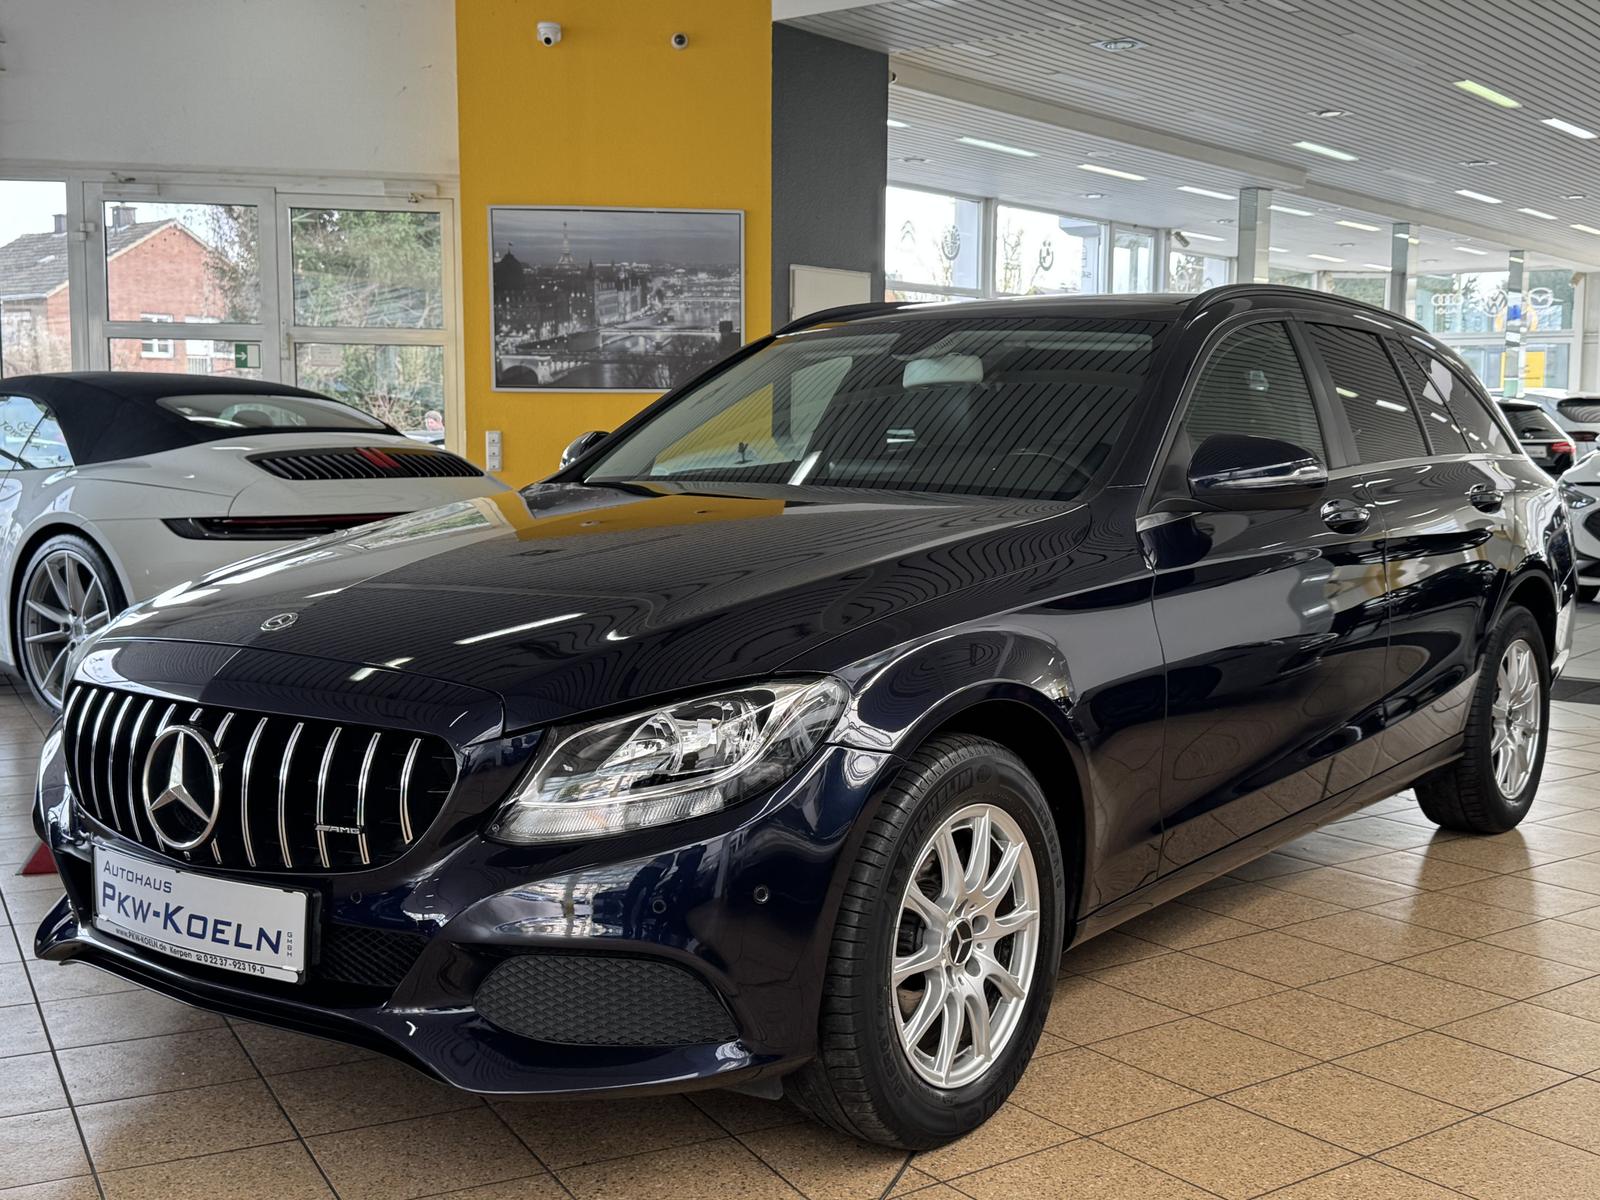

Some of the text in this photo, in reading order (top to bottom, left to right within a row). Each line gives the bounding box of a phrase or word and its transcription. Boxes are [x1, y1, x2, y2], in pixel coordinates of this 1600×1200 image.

[328, 826, 360, 834] AMG
[902, 768, 971, 859] MICHELIN
[104, 860, 172, 893] AUTOHAUS
[102, 881, 281, 954] PKW-KOELN
[169, 946, 193, 959] Kerpen
